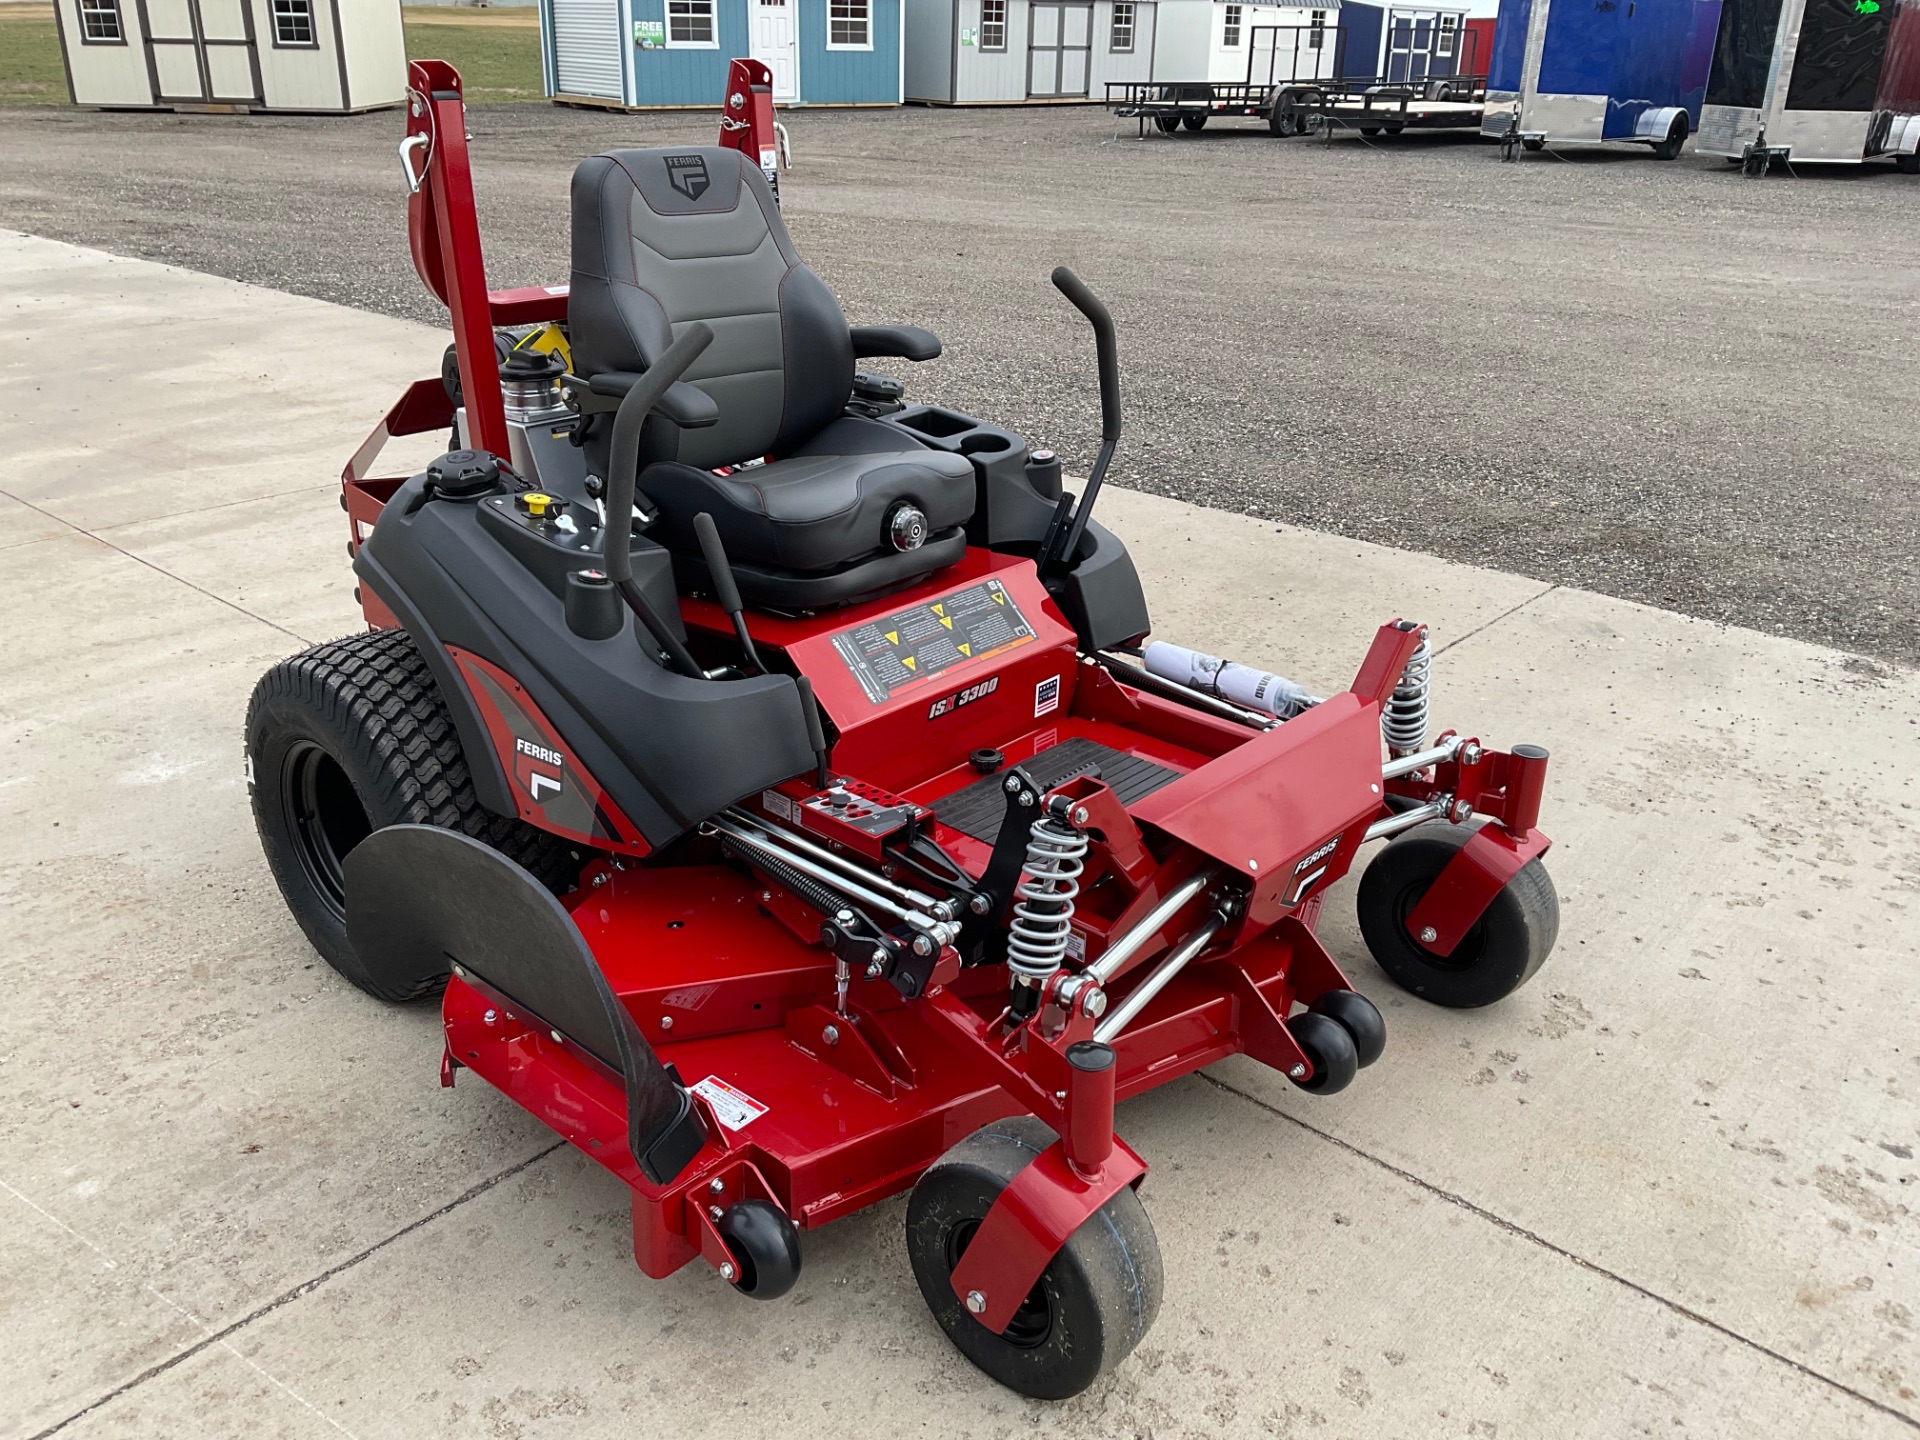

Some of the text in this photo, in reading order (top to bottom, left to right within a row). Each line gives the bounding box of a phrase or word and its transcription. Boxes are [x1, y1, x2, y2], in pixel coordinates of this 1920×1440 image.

[634, 21, 663, 31] FREE
[668, 156, 702, 166] FERRIS
[928, 676, 999, 719] ISX 3300
[1255, 673, 1273, 700] UARD
[516, 738, 562, 766] FERRIS
[1294, 838, 1338, 875] FERRIS
